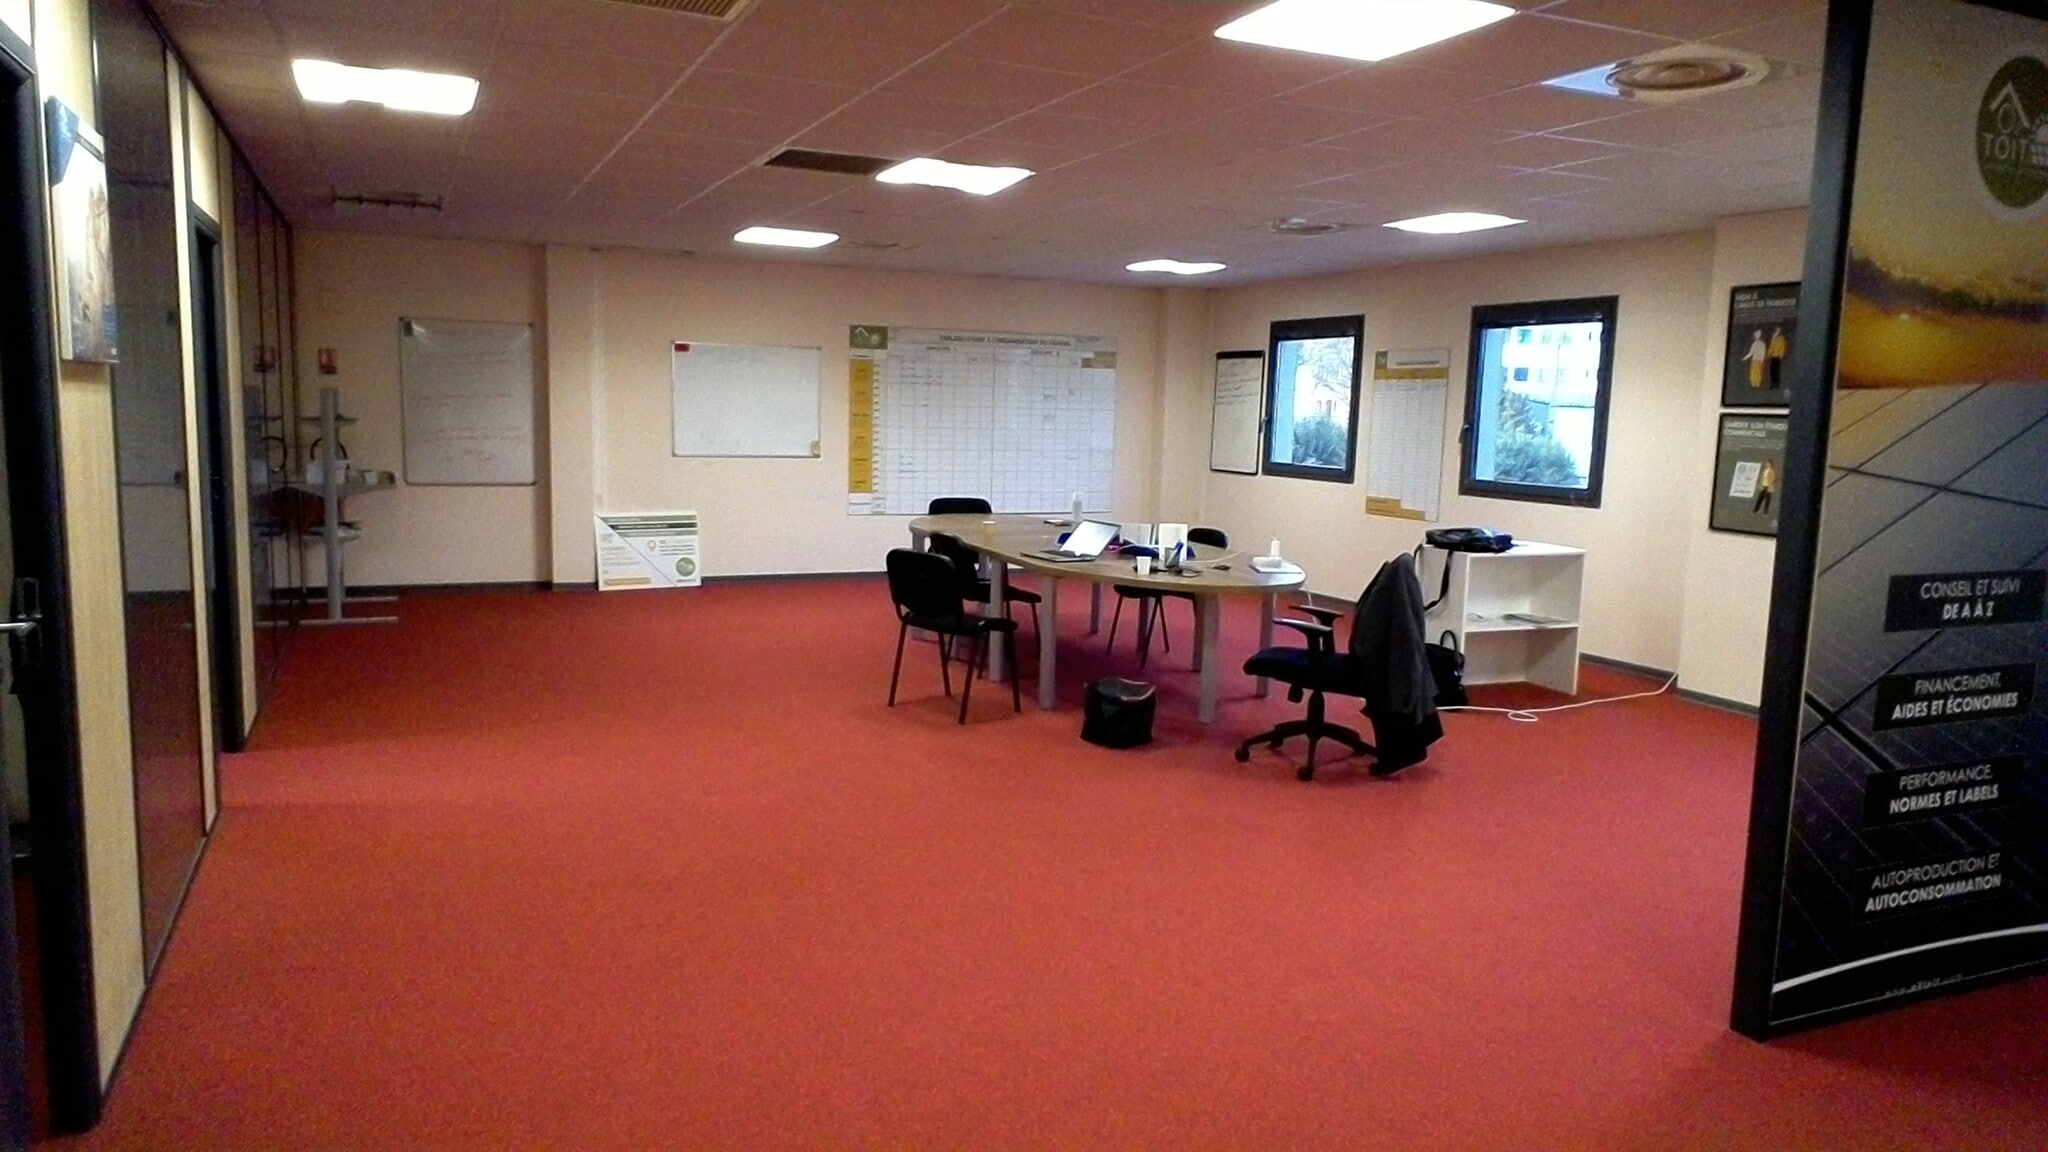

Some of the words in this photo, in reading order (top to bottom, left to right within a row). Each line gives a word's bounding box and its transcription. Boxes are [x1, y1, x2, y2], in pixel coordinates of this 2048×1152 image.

[1920, 580, 1973, 599] CONSEIL
[1975, 579, 1989, 596] ET
[1990, 578, 2021, 595] SUIVI
[1942, 602, 1959, 620] DE
[1961, 603, 1971, 618] A
[1973, 598, 1984, 617] À
[1986, 601, 1995, 618] Z
[1891, 701, 1928, 720] AIDES
[1930, 699, 1944, 716] ET
[1945, 691, 2019, 715] ÉCONOMIES
[1899, 764, 1993, 790] PERFORMANCE
[1889, 792, 1941, 815] NORMES
[1943, 789, 1957, 806] ET
[1958, 783, 1999, 804] LABELS
[1871, 855, 1985, 890] AUTOPRODUCTION
[1987, 852, 2001, 869] ET
[1865, 873, 2002, 912] AUTOCONSOMMATION
